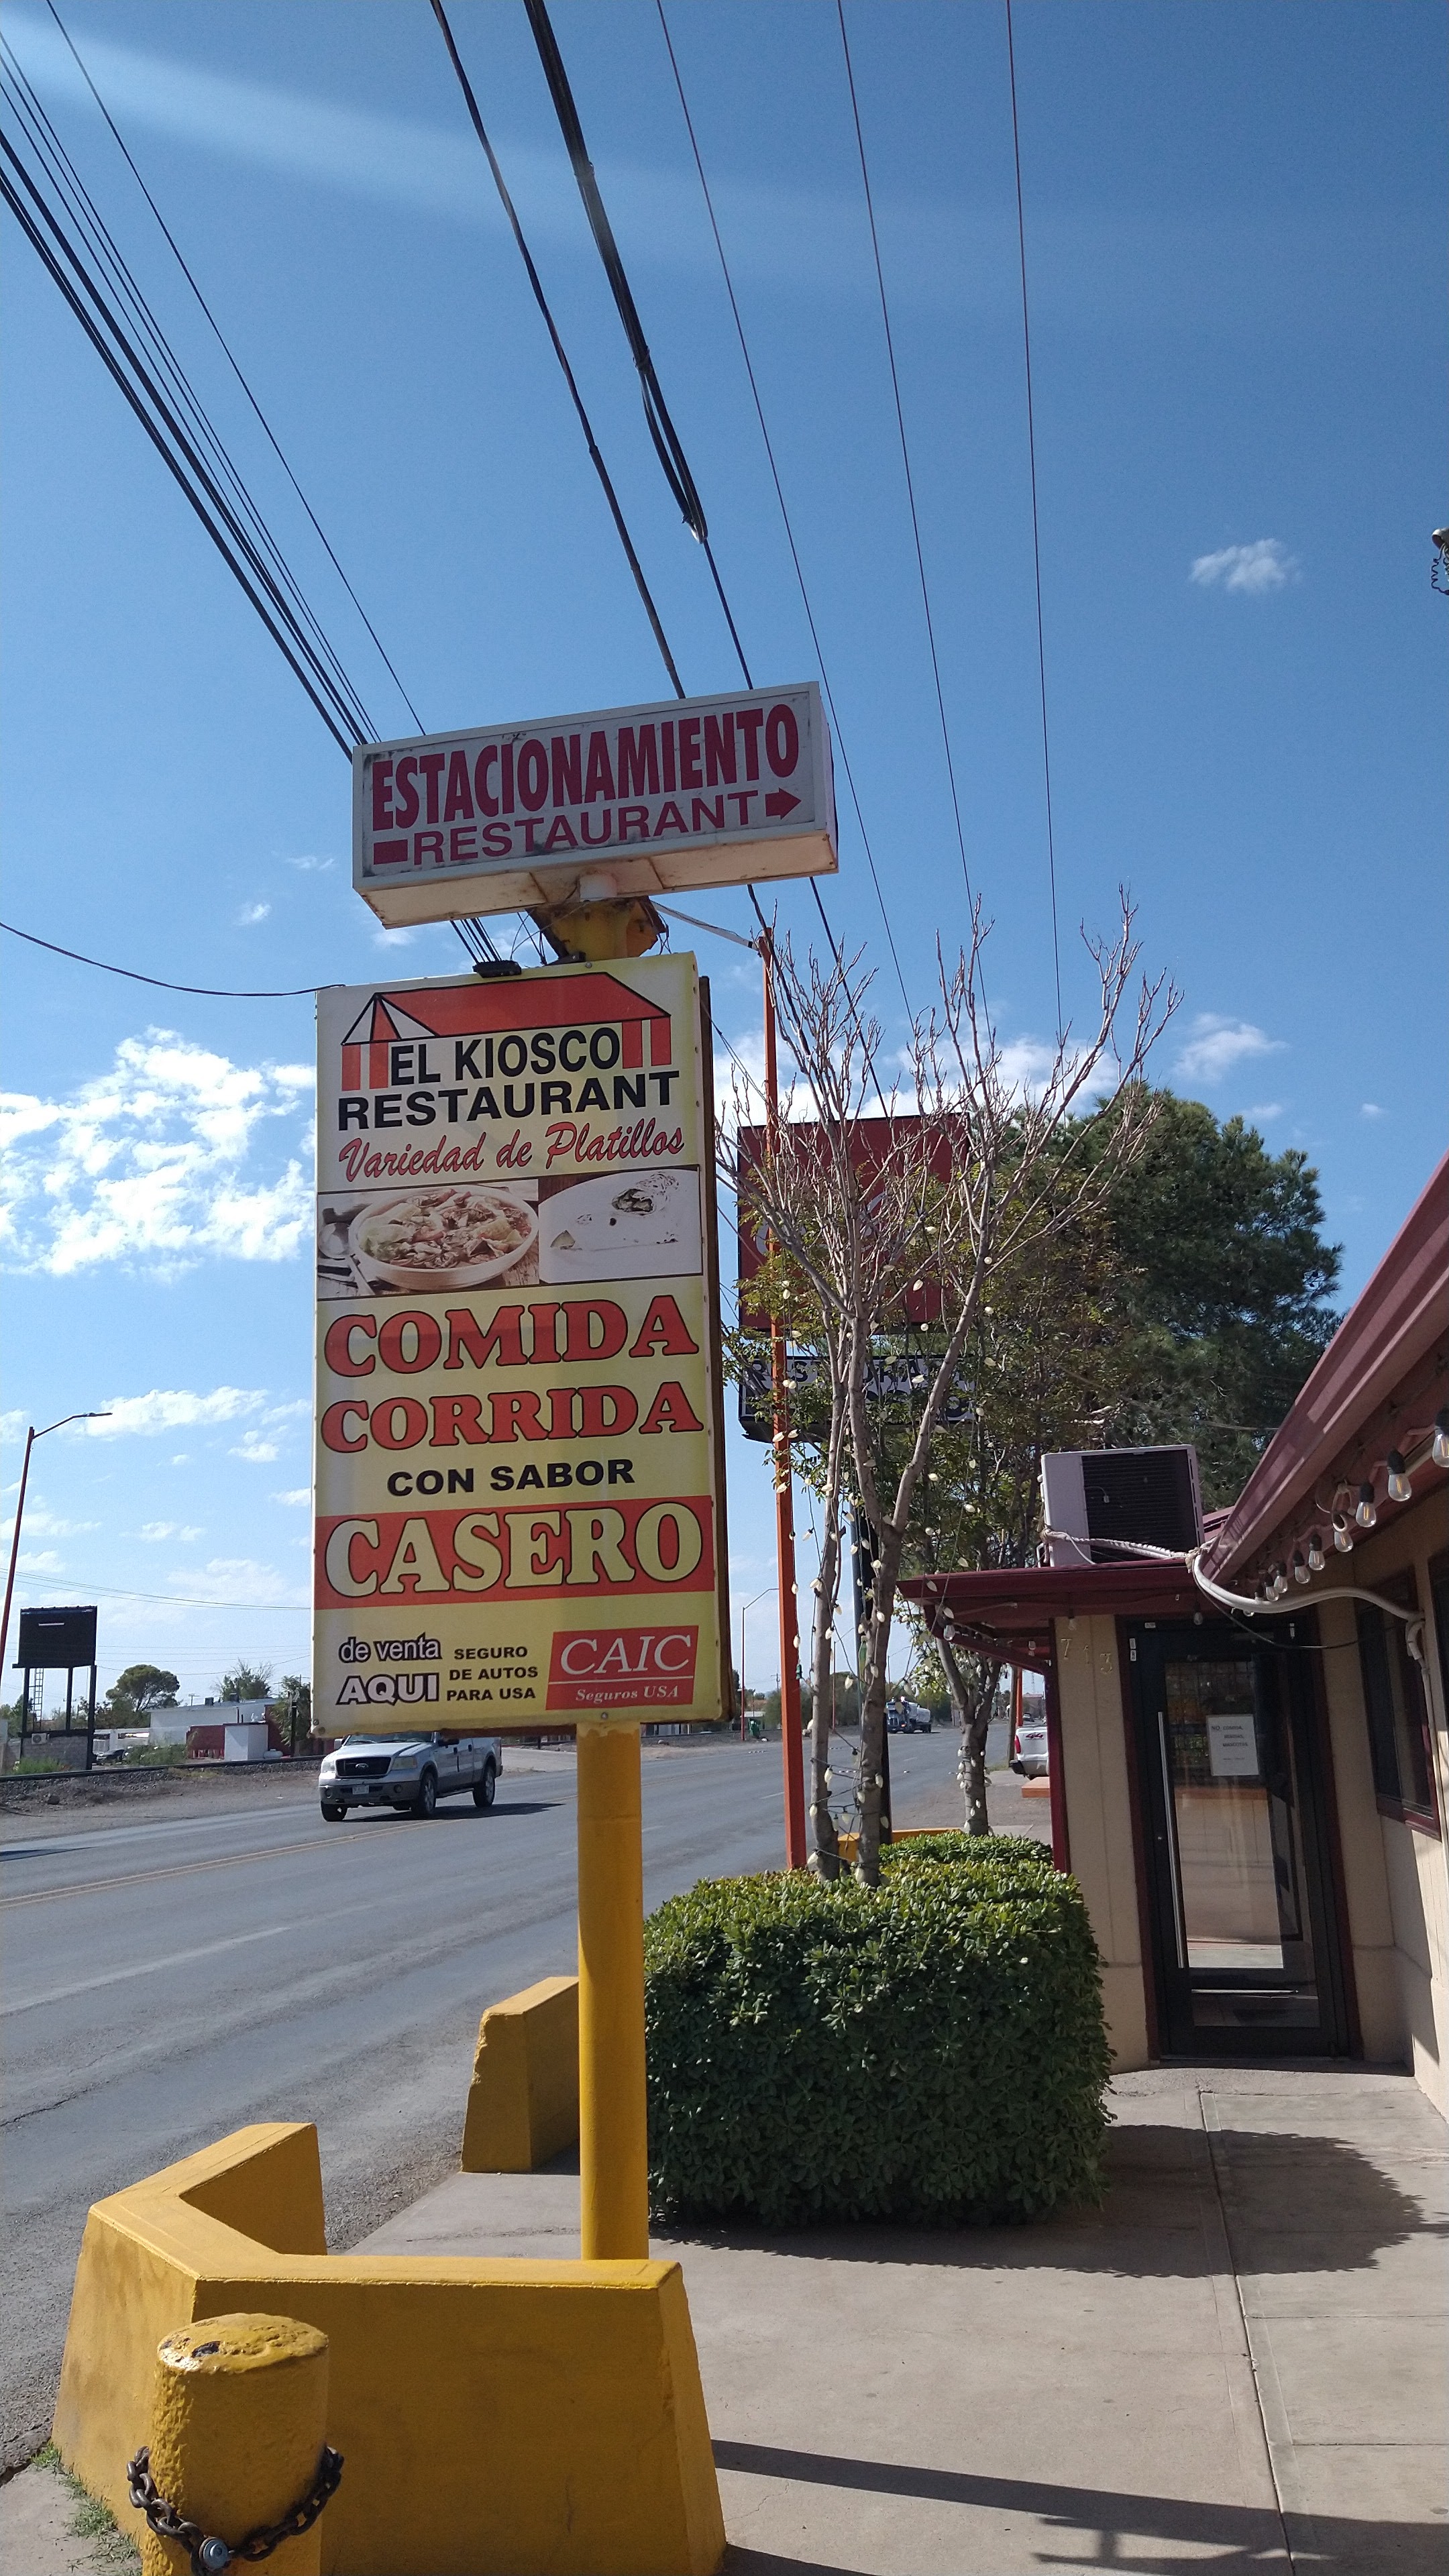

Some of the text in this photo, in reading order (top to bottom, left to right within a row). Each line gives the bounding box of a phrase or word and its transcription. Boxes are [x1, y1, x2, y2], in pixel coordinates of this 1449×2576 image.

[372, 704, 800, 831] ESTACIONAMIENTO
[413, 790, 759, 865] RESTAURANT
[390, 1027, 621, 1087] EL KIOSCO
[337, 1071, 680, 1131] RESTAURANT
[338, 1118, 685, 1182] Variedad de Platillos
[324, 1294, 700, 1377] COMIDA
[321, 1381, 704, 1453] CORRIDA
[386, 1458, 635, 1497] CON SABOR
[325, 1501, 703, 1598] CASERO
[337, 1631, 443, 1664] de venta
[449, 1665, 539, 1681] DE AUTOS
[453, 1646, 529, 1660] SEGURO
[559, 1634, 692, 1676] CAIC
[336, 1672, 441, 1707] AQUI
[446, 1687, 536, 1702] PARA USA
[575, 1684, 680, 1705] Seguros USA
